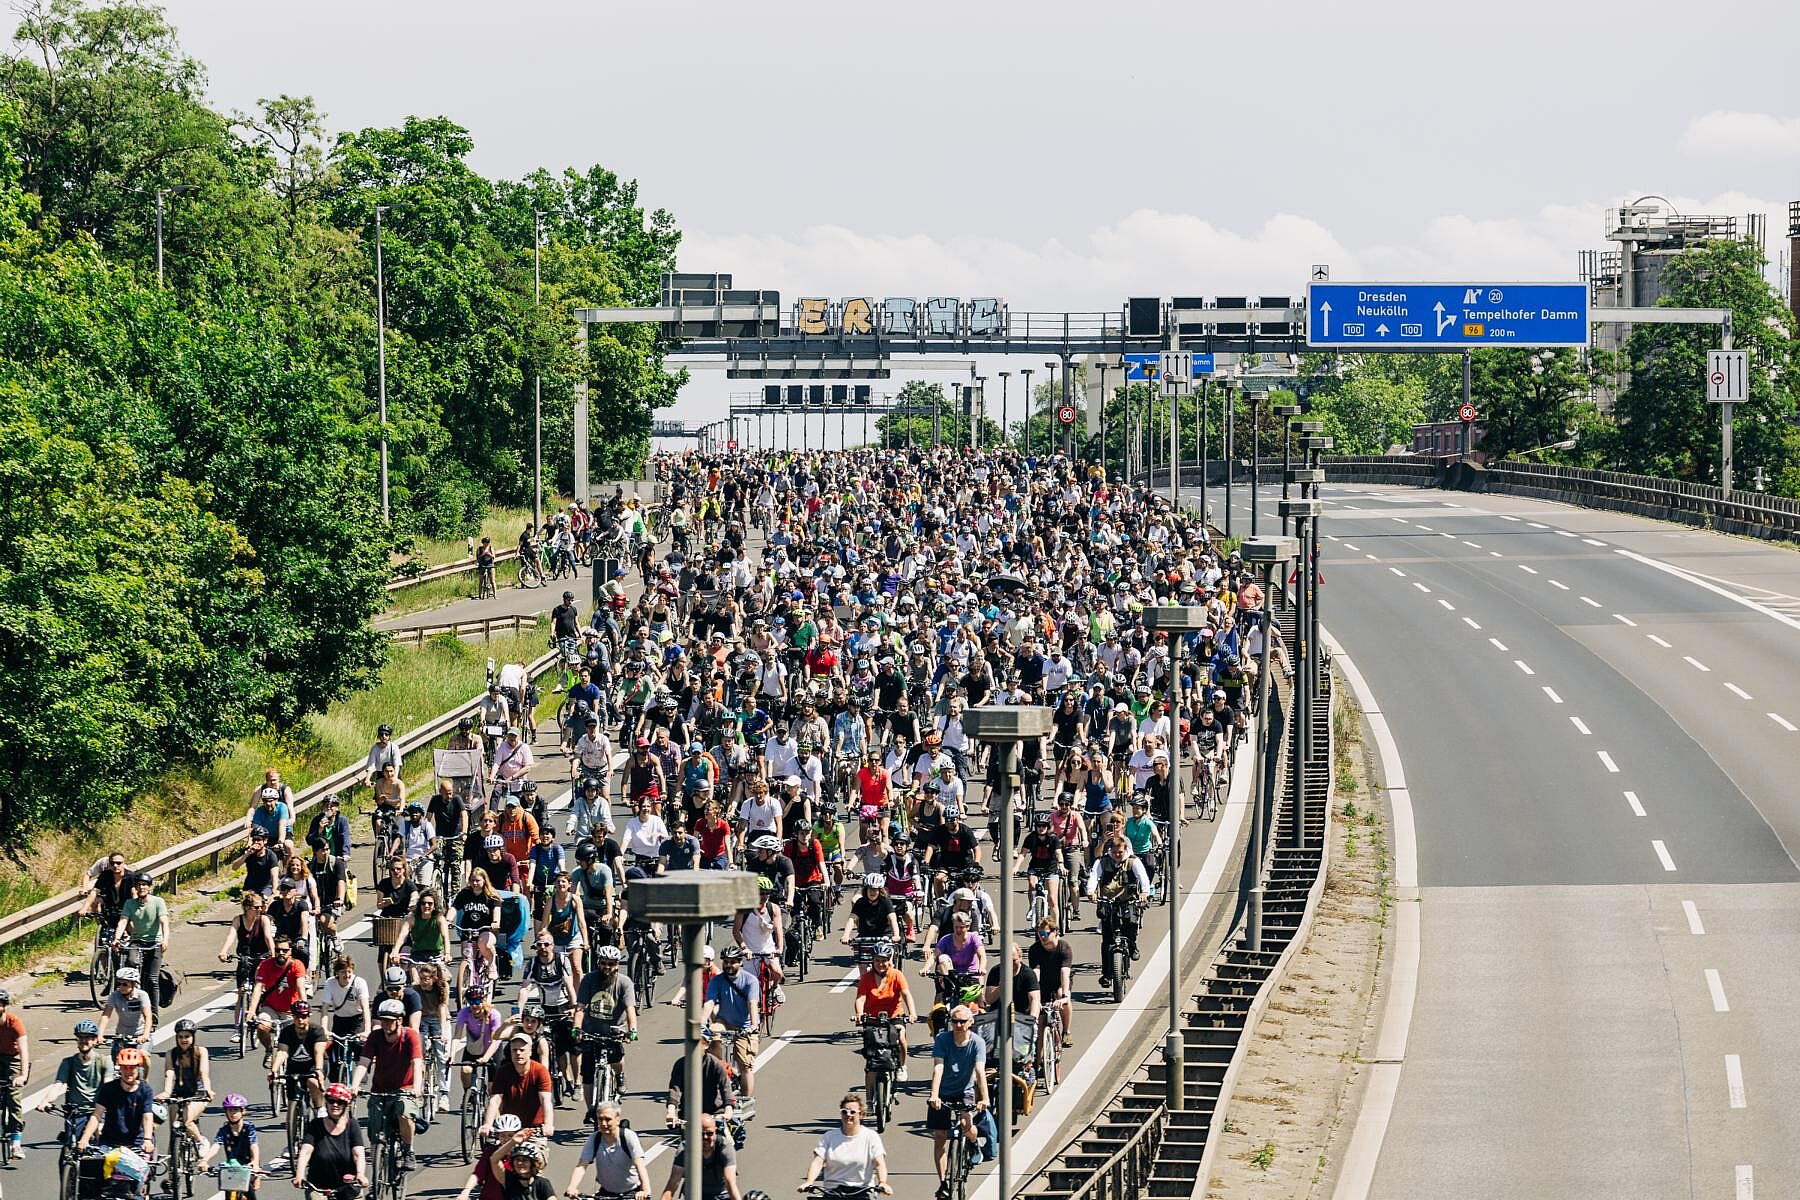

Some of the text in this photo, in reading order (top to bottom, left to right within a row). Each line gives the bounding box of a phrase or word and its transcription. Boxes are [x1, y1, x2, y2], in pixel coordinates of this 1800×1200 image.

[1358, 291, 1407, 302] Dresden
[1491, 291, 1501, 301] 20
[1357, 305, 1408, 317] Neukölln
[1463, 309, 1578, 322] Tempelhofer Damm
[1346, 326, 1361, 335] 100
[1404, 326, 1419, 335] 100
[1468, 326, 1479, 335] 96
[1489, 328, 1506, 337] 200
[1062, 410, 1072, 419] 80
[1463, 408, 1473, 418] 80
